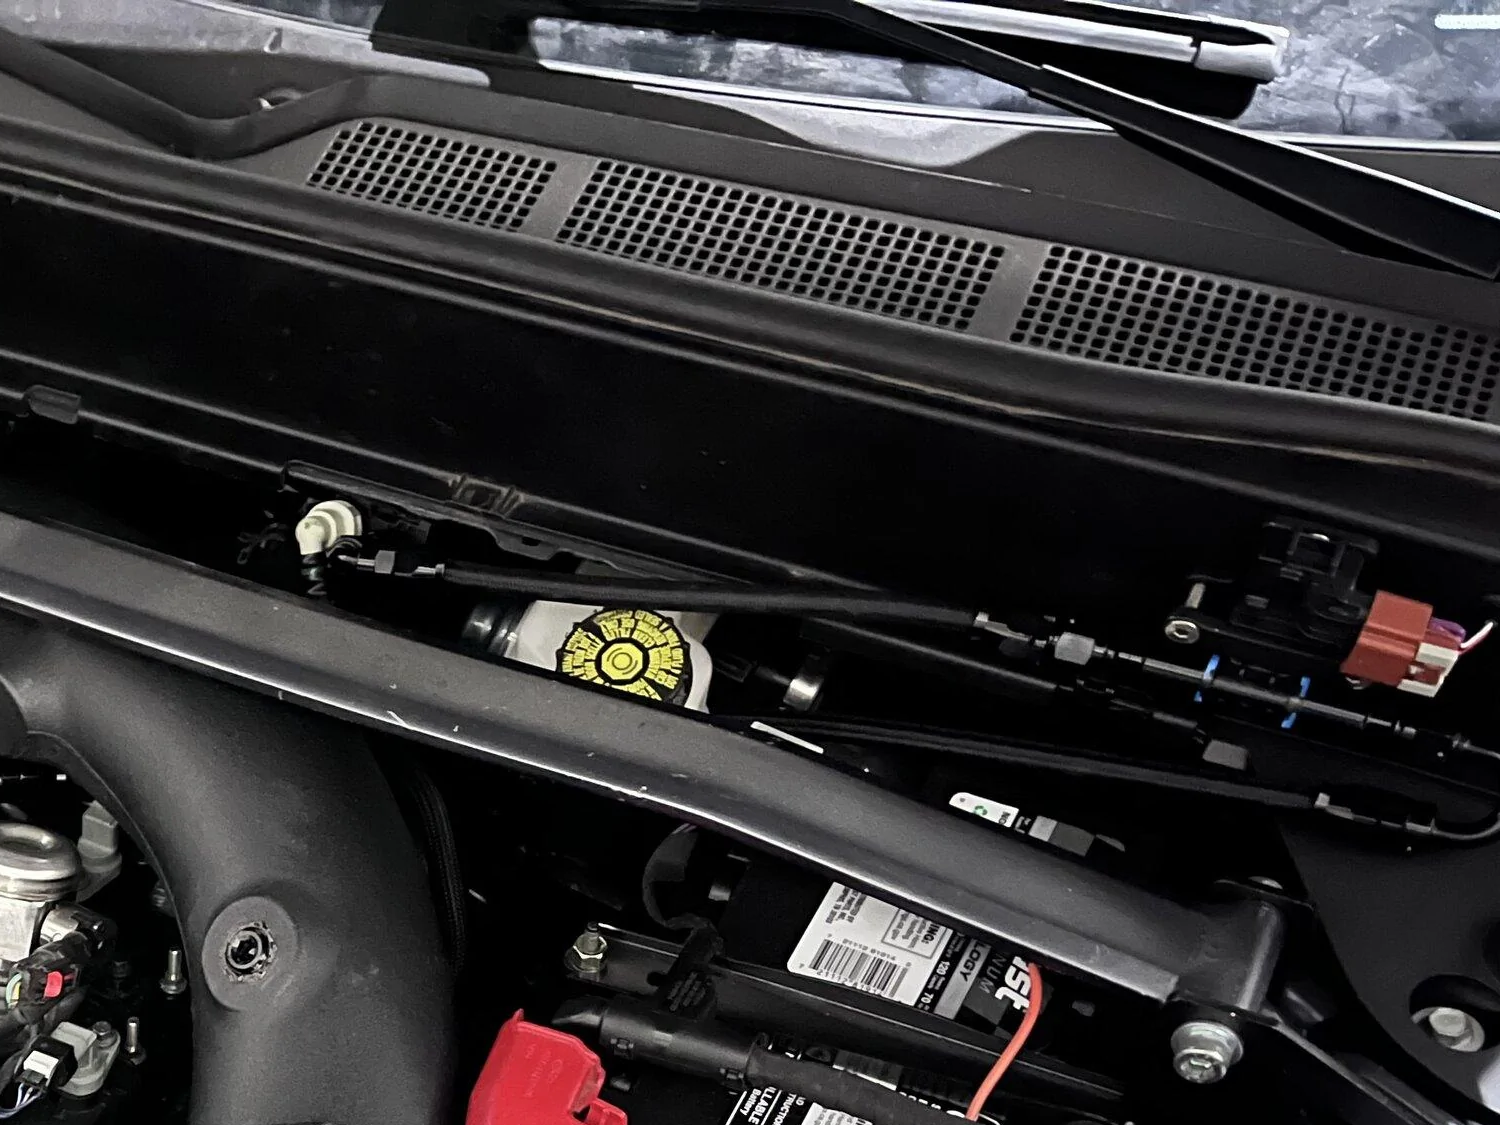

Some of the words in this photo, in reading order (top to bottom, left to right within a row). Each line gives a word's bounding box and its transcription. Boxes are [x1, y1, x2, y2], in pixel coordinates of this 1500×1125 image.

[921, 922, 940, 944] ING:
[936, 961, 950, 975] 120
[960, 940, 985, 981] LOGY
[977, 958, 1006, 994] NUM
[920, 992, 934, 1004] 70
[740, 1088, 761, 1116] Battery
[748, 1086, 776, 1124] ILLABLE
